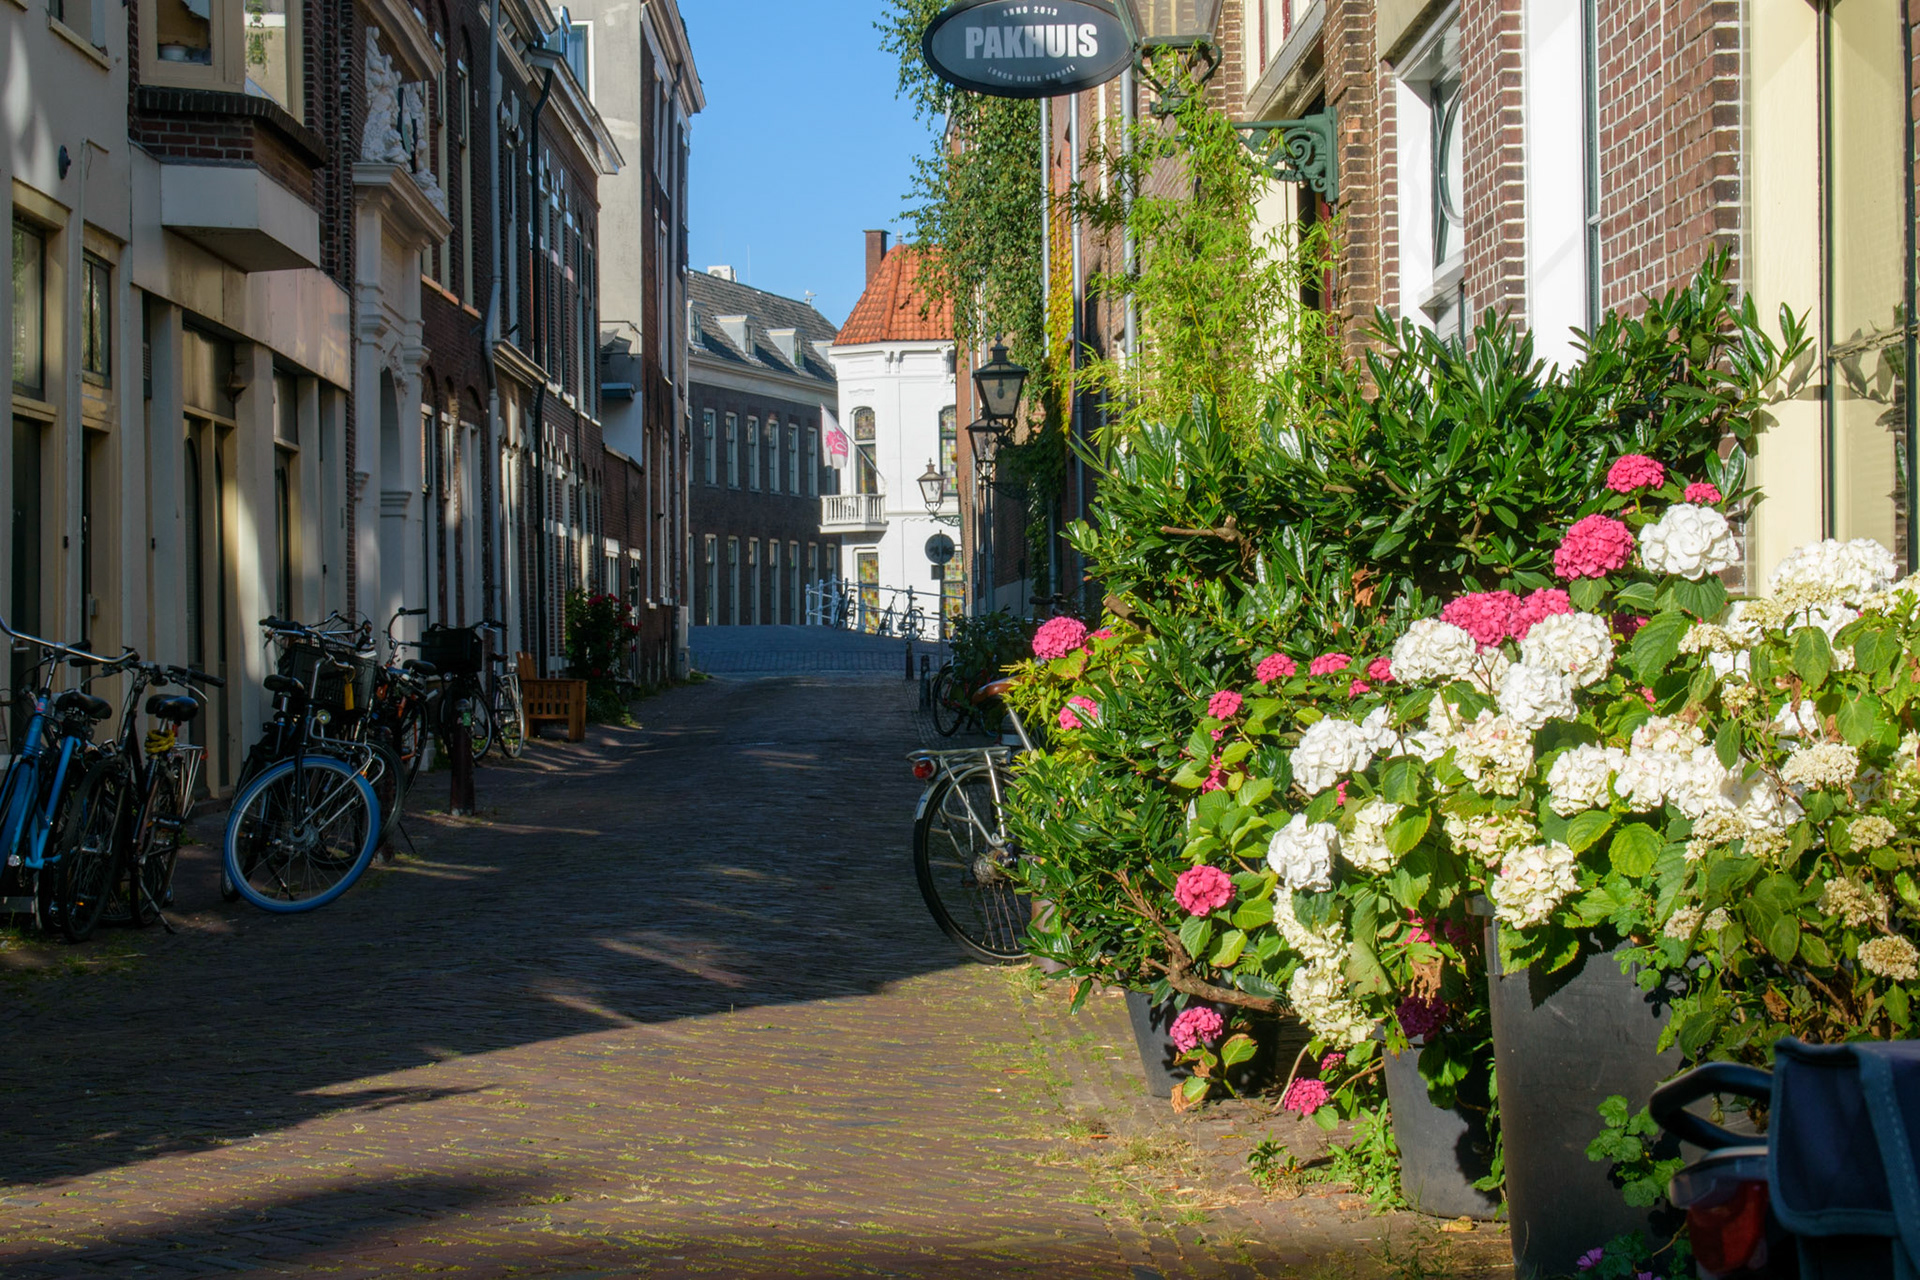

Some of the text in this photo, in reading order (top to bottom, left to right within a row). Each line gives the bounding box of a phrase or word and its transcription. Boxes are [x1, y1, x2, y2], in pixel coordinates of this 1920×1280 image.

[1003, 5, 1058, 17] ANNO 2013
[965, 23, 1098, 59] PAKHUIS
